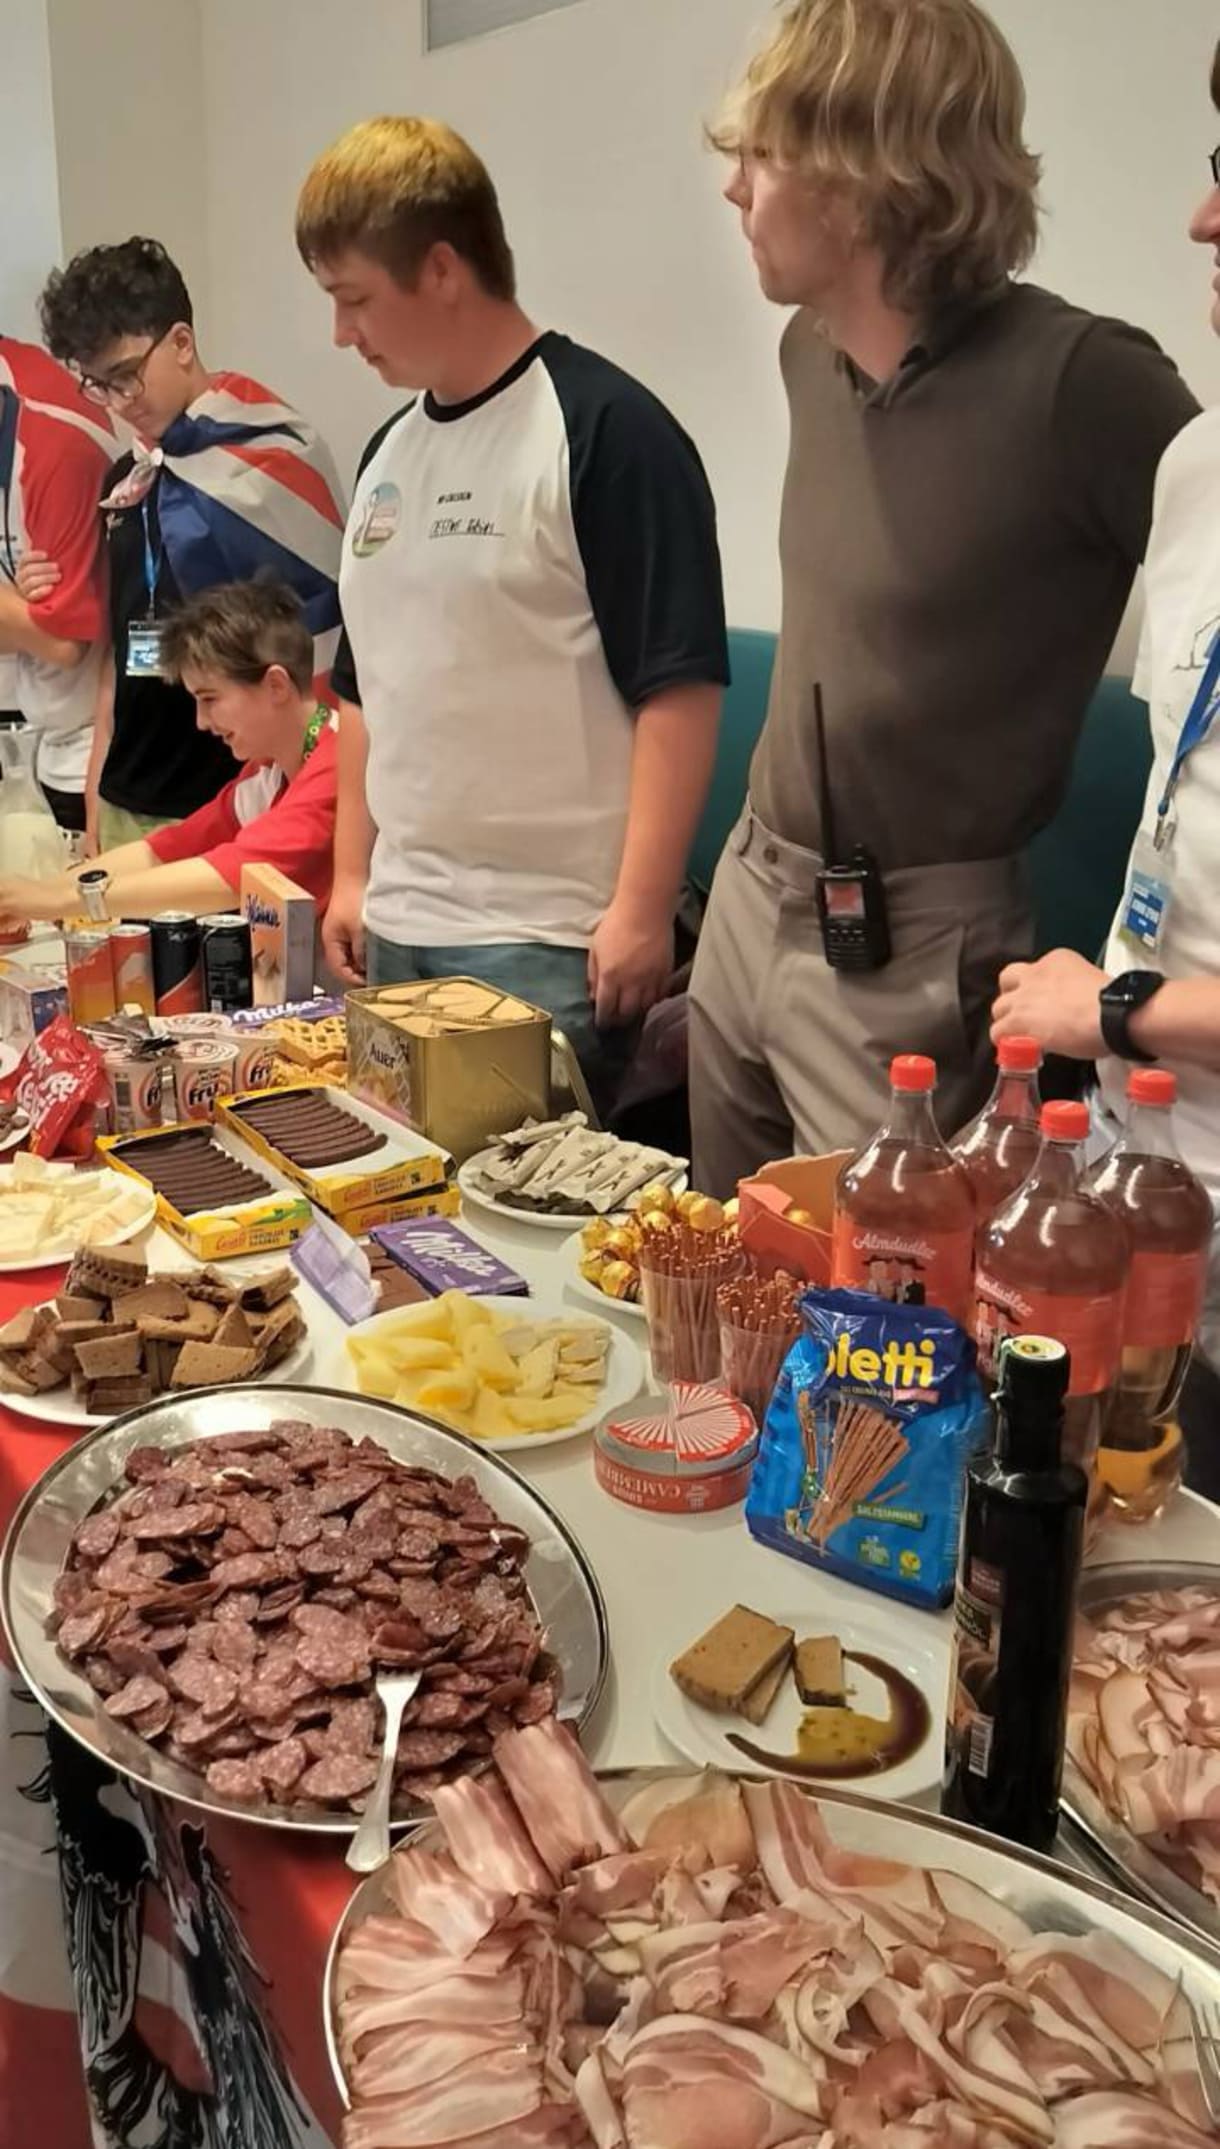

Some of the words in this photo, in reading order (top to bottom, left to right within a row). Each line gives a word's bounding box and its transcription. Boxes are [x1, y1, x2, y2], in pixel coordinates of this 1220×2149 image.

[233, 1000, 321, 1022] Milka
[370, 1043, 396, 1070] Auer
[400, 1231, 497, 1277] Milka
[826, 1332, 937, 1388] letti
